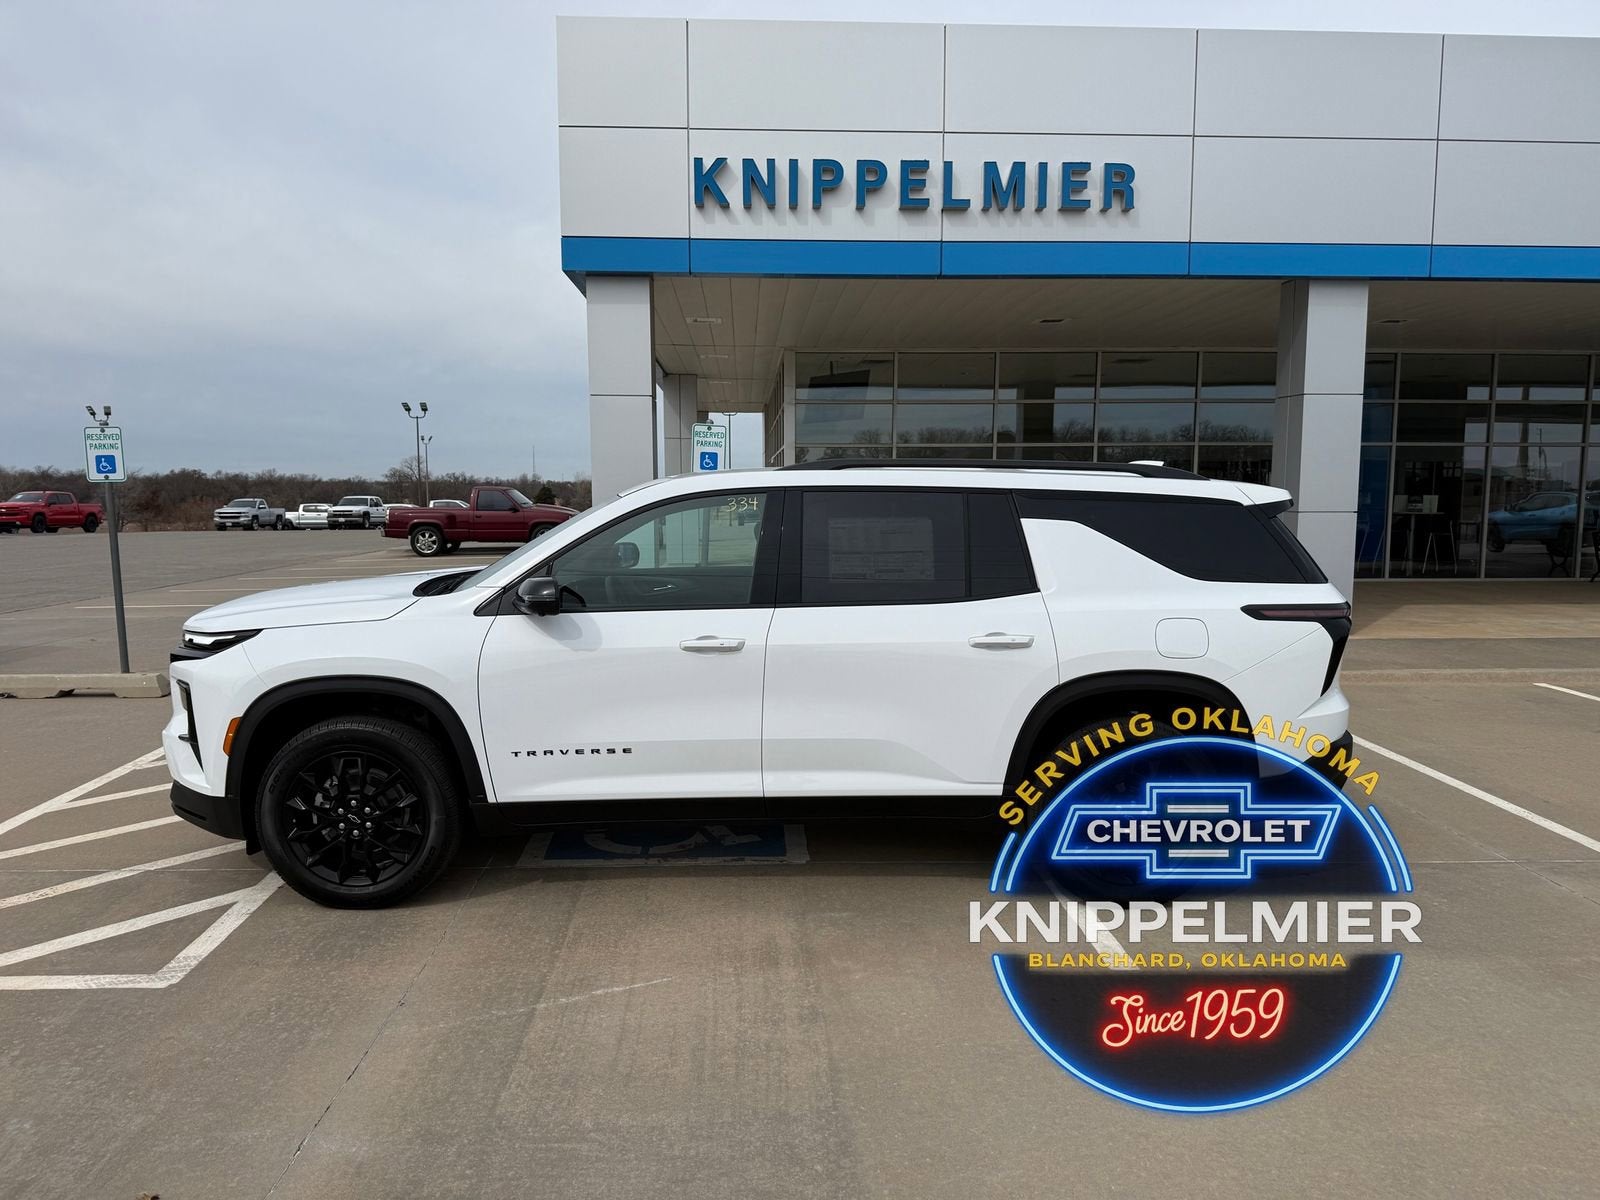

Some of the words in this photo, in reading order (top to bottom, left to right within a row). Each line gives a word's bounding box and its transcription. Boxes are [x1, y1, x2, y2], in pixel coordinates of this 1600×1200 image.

[693, 157, 1136, 212] KNIPPELMIER
[86, 433, 120, 441] RESERVED
[694, 430, 725, 439] RESERVED
[89, 442, 119, 450] PARKING
[696, 440, 723, 448] PARKING
[727, 496, 758, 512] 334
[510, 747, 633, 758] TRAVERSE
